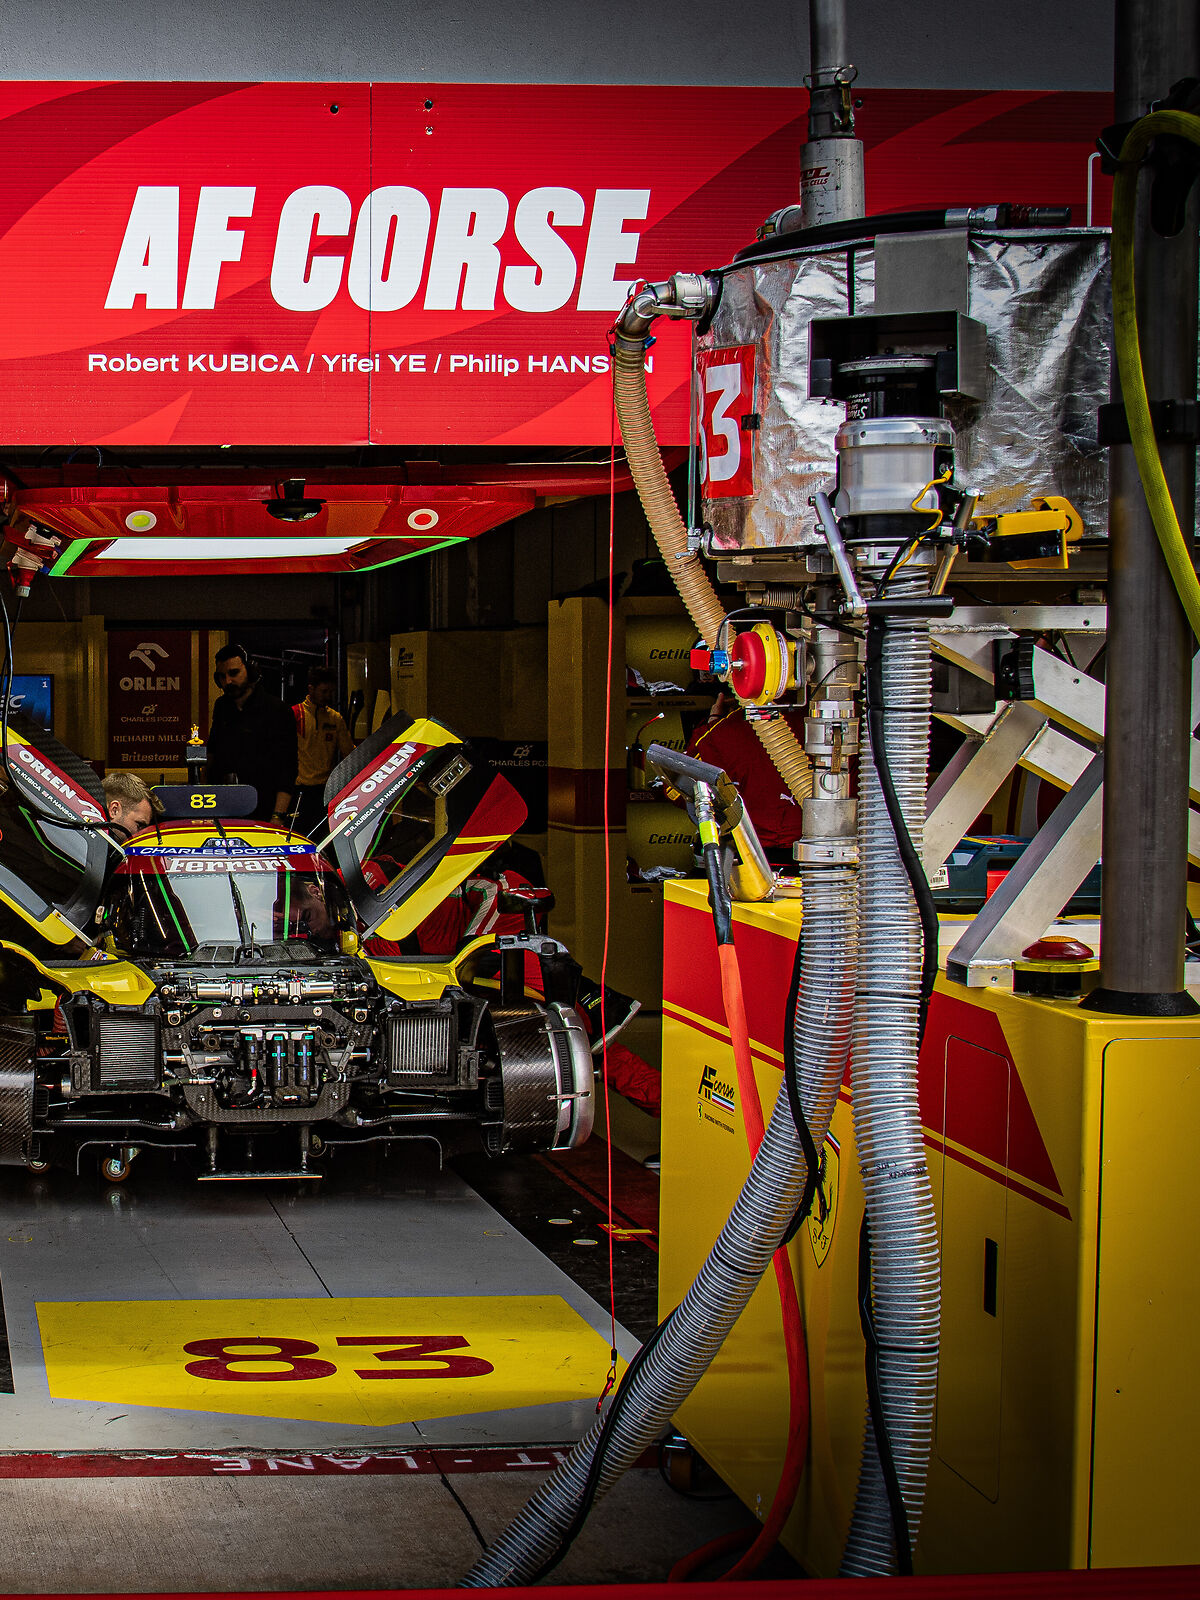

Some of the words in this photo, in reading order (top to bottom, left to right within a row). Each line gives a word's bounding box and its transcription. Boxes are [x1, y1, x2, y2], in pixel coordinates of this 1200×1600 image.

[104, 186, 256, 310] AF
[270, 185, 651, 312] CORSE
[87, 353, 179, 372] Robert
[188, 354, 299, 372] KUBICA
[321, 354, 380, 373] Yifei
[387, 354, 427, 372] YE
[449, 354, 520, 377] Philip
[528, 355, 653, 373] HANSN
[119, 676, 180, 691] ORLEN
[113, 735, 156, 743] RICHARD
[360, 743, 417, 793] ORLEN
[488, 759, 530, 767] CHARLES
[18, 750, 77, 800] ORLEN
[20, 773, 42, 792] KUBICA
[384, 776, 408, 799] HANSON
[190, 794, 217, 809] 83
[355, 808, 376, 828] KUBICA
[140, 846, 228, 855] CHARLES
[232, 847, 284, 855] POZZI
[166, 855, 296, 873] Ferrari
[183, 1336, 495, 1382] 83
